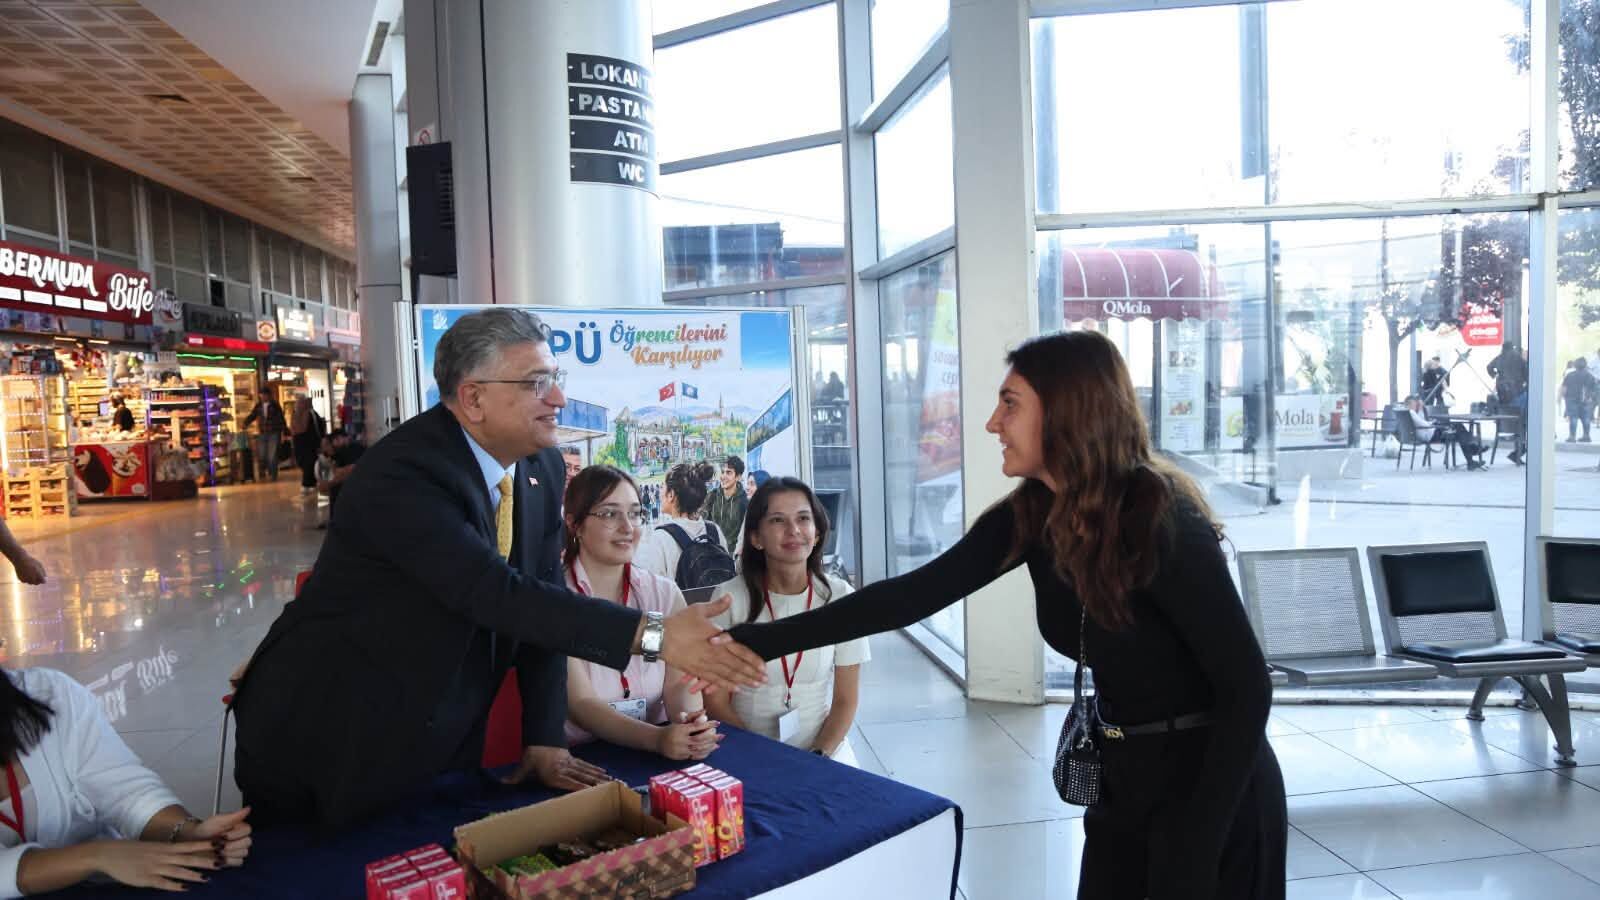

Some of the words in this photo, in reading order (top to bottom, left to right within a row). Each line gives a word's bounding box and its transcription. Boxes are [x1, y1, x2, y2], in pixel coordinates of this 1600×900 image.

[613, 130, 649, 153] ATM
[618, 162, 645, 182] WC
[0, 248, 99, 297] BERMUDA
[109, 273, 154, 318] Büfe
[1103, 300, 1152, 317] QMola
[609, 320, 727, 351] Öğrencilerini
[630, 344, 723, 369] Karşılıyor
